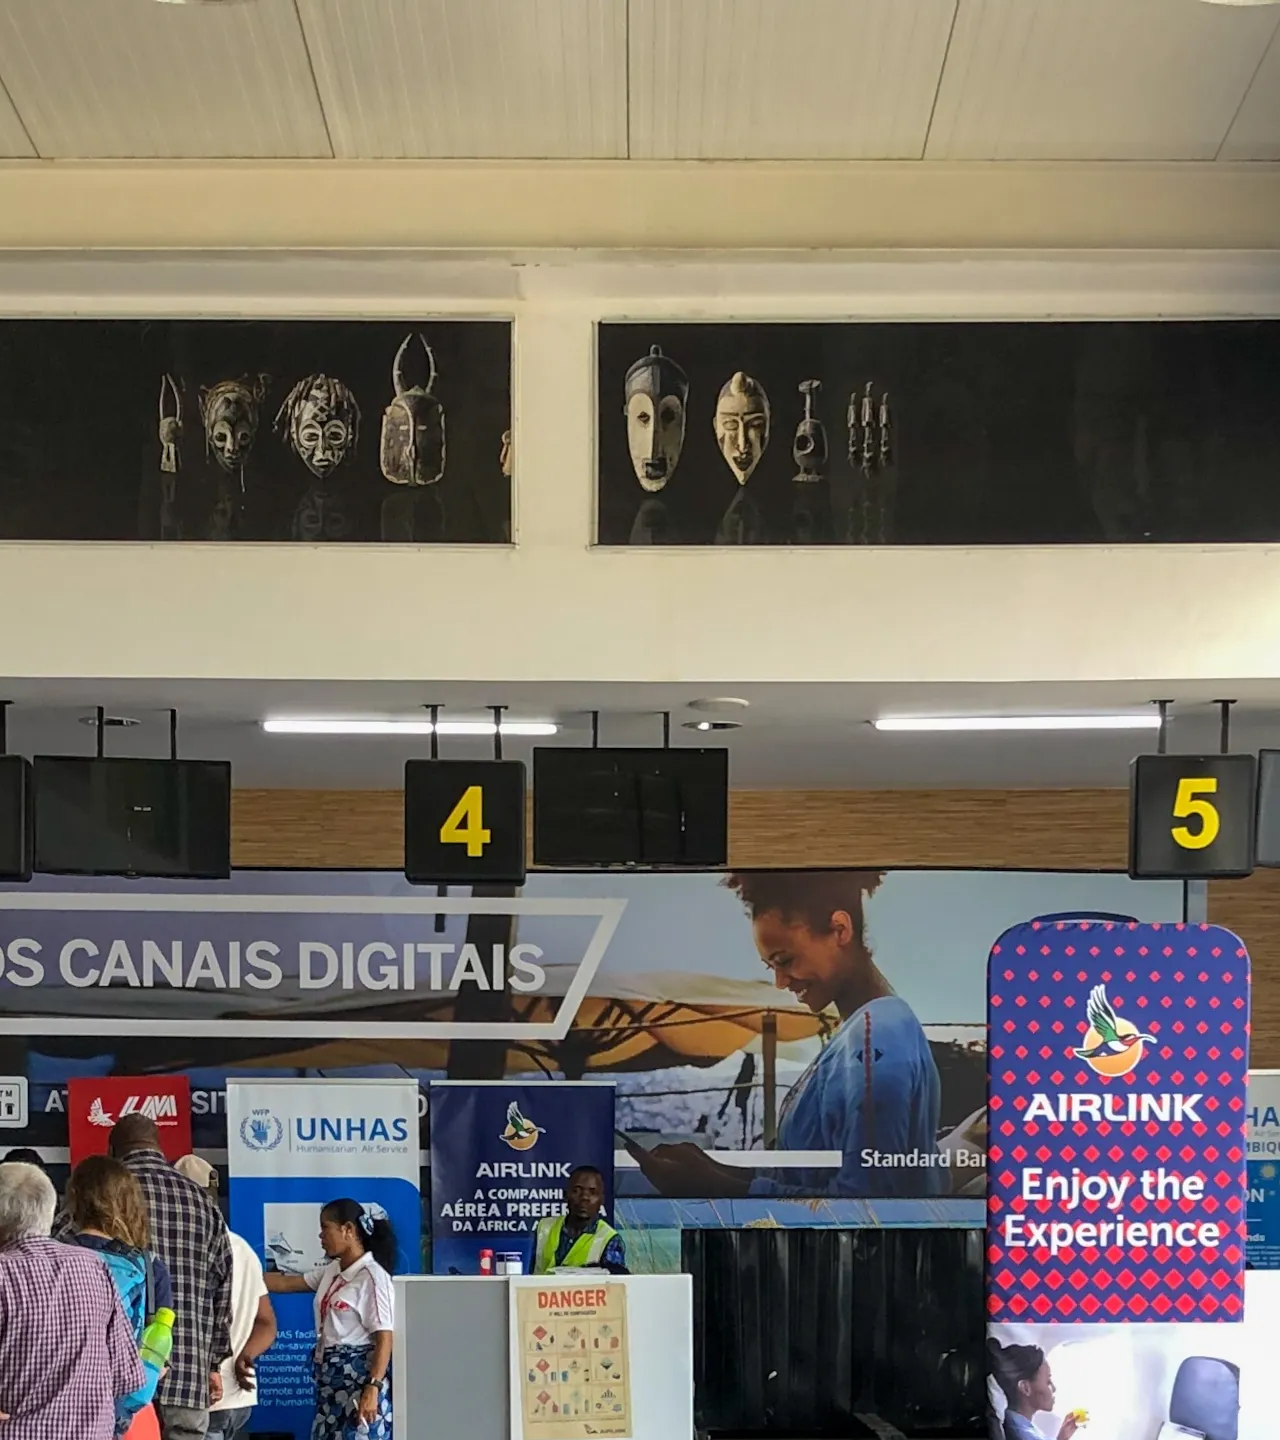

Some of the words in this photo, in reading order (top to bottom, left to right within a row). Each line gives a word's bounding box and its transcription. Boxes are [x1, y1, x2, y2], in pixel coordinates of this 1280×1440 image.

[439, 786, 491, 857] 4
[1171, 778, 1220, 849] 5
[59, 938, 282, 989] CANAIS
[300, 942, 545, 992] DIGITAIS
[252, 1109, 270, 1117] WFP
[1022, 1093, 1204, 1122] AIRLINK
[296, 1117, 408, 1142] UNHAS
[296, 1145, 358, 1153] Humanitarian
[361, 1145, 375, 1153] Air
[376, 1145, 408, 1154] Service
[860, 1148, 951, 1167] Standard
[476, 1163, 572, 1178] AIRLINK
[474, 1189, 484, 1200] A
[488, 1188, 563, 1200] COMPANHI
[1022, 1167, 1131, 1210] Enjoy
[1140, 1168, 1204, 1201] the
[440, 1199, 501, 1217] AÉREA
[452, 1221, 472, 1232] DA
[477, 1218, 528, 1232] ÁFRICA
[1004, 1214, 1220, 1256] Experience
[538, 1289, 607, 1309] DANGER
[260, 1375, 301, 1384] locations
[260, 1387, 293, 1395] remote
[296, 1387, 314, 1395] and
[260, 1398, 272, 1406] for
